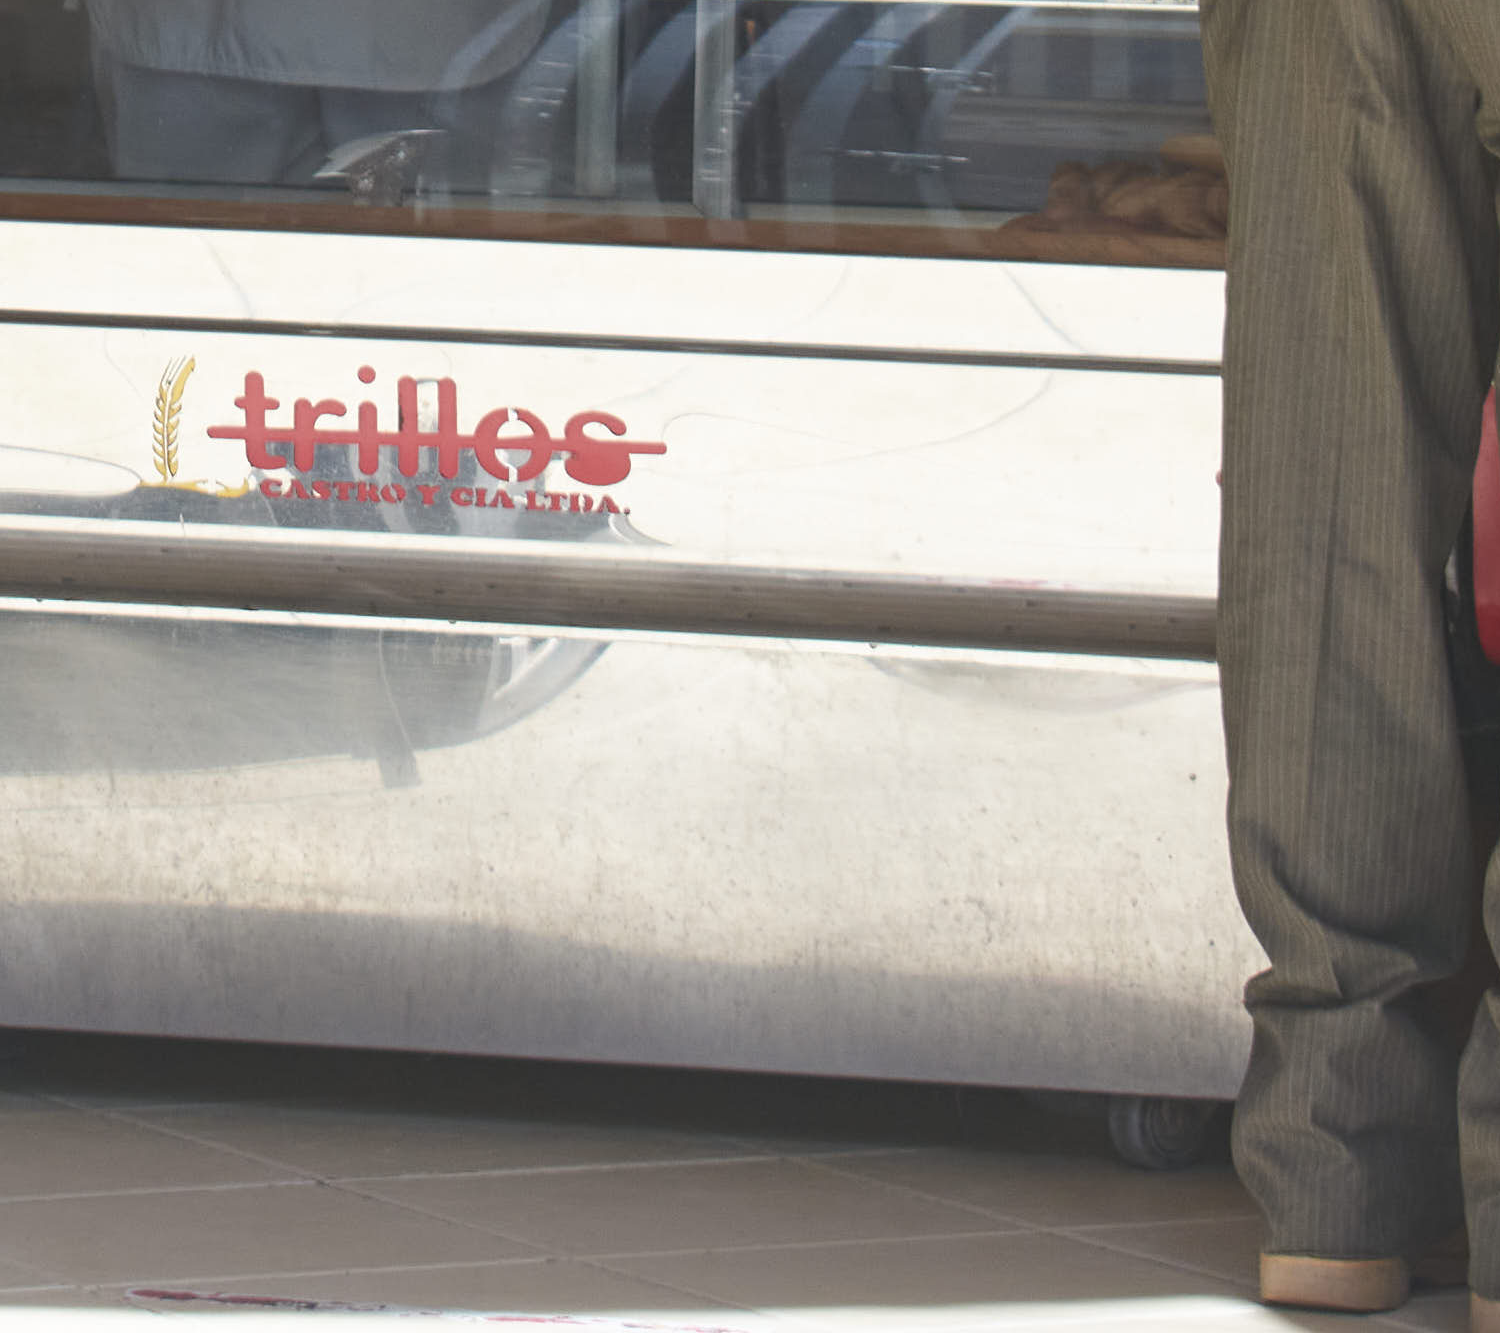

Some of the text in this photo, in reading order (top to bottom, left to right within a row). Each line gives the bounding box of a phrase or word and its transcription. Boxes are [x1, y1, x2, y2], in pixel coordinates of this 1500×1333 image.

[260, 477, 406, 506] CASTRO
[416, 482, 442, 506] Y
[450, 485, 517, 511] CIA
